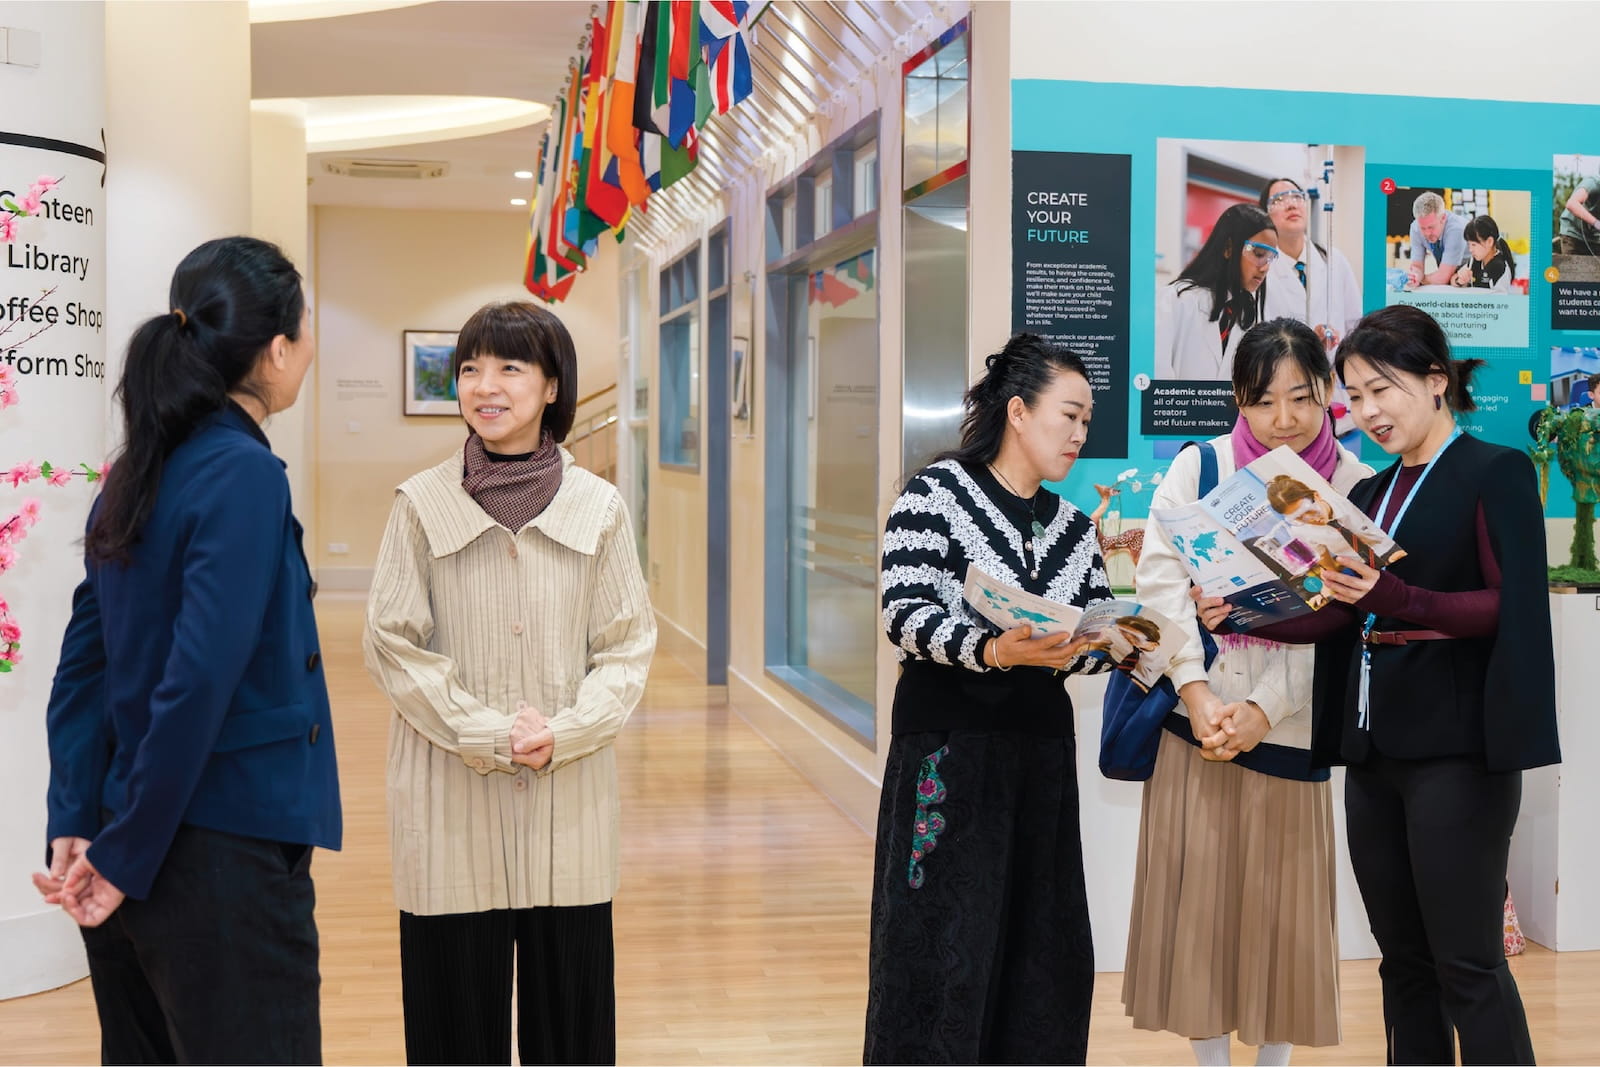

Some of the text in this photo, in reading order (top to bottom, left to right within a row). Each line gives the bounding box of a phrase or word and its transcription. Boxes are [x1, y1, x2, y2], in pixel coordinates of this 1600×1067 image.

[1027, 191, 1088, 206] CREATE
[0, 190, 93, 226] Cnteen
[1026, 210, 1072, 224] YOUR
[1027, 229, 1089, 244] FUTURE
[8, 244, 89, 281] Library
[1026, 261, 1107, 271] From exceptional academic
[1056, 270, 1077, 278] having
[1558, 287, 1572, 296] We
[1573, 288, 1591, 297] have
[1080, 299, 1112, 307] everything
[1414, 300, 1460, 309] world-class
[1460, 301, 1495, 310] teachers
[1558, 298, 1592, 307] students
[1465, 312, 1499, 321] inspiring
[1558, 308, 1578, 316] want
[66, 302, 103, 333] Shop
[1450, 322, 1487, 331] nurturing
[75, 354, 105, 384] Shop
[1153, 387, 1236, 397] Academic excellenc
[1153, 397, 1164, 406] all
[1165, 397, 1175, 406] of
[1191, 398, 1227, 407] thinkers,
[1153, 409, 1188, 417] creators
[1153, 418, 1230, 427] and future makers.
[1223, 492, 1257, 521] CREATE
[1229, 504, 1256, 525] YOUR
[1235, 504, 1270, 532] FUTURE
